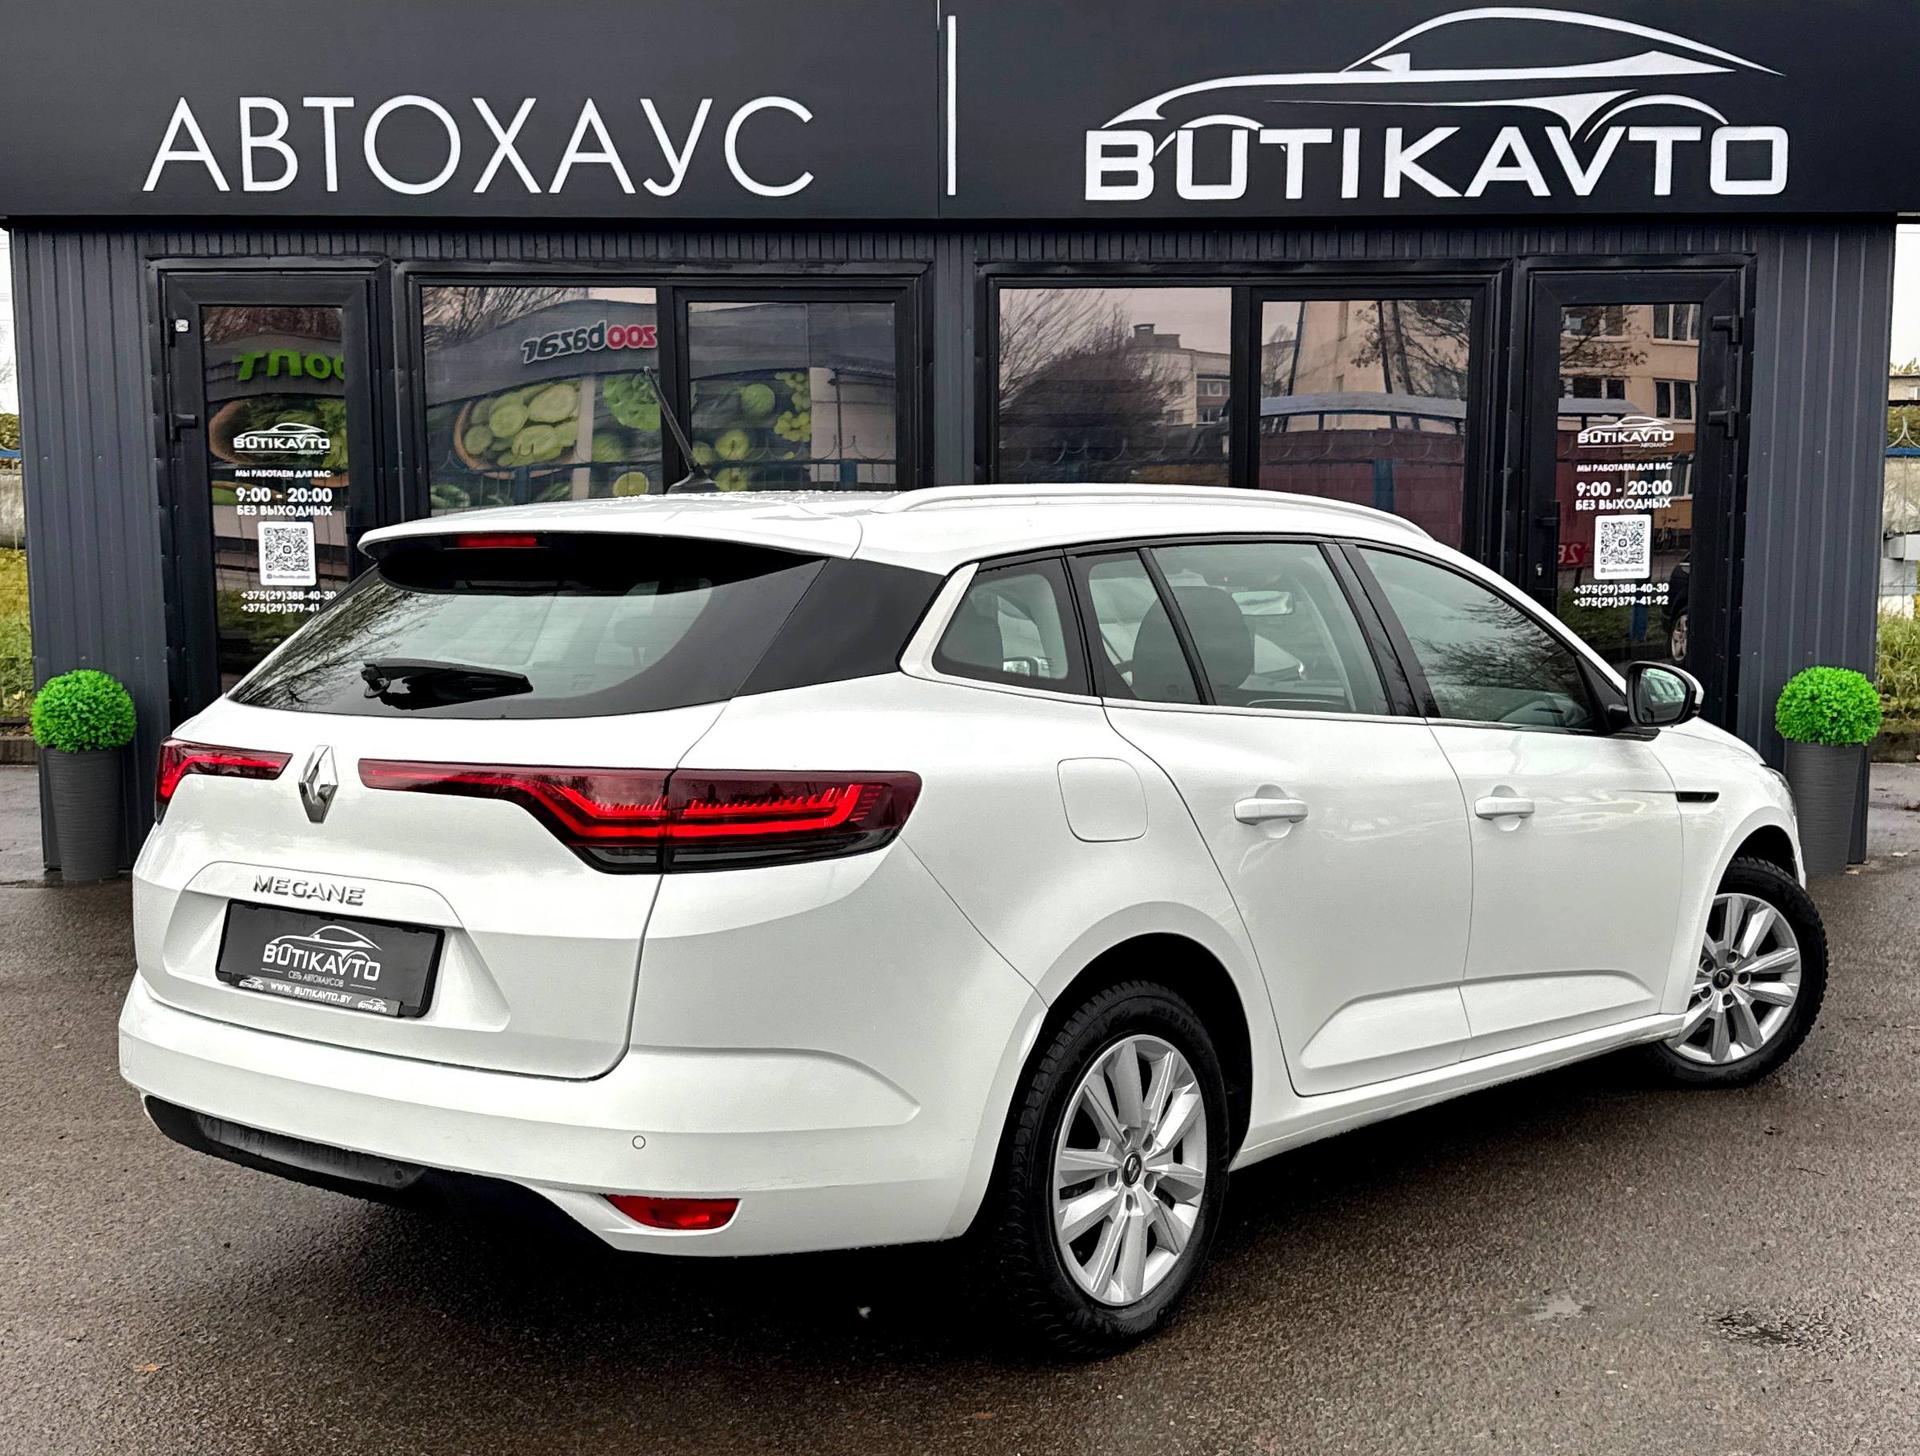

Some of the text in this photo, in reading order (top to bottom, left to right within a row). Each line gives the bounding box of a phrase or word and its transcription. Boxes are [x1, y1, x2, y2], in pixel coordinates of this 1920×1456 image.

[143, 95, 814, 197] АВТОХАУС
[1085, 126, 1789, 200] BUTIKAVTO
[233, 437, 331, 449] BUTIKAVTO
[1577, 430, 1674, 444] BUTIKAVTO
[235, 469, 331, 479] МЫ РАБОТАЕМ ДЛЯ ВАС
[1576, 462, 1673, 473] МЫ РАБОТАЕМ ДЛЯ ВАС
[236, 487, 272, 502] 9:00
[287, 487, 333, 502] 20:00
[1576, 481, 1611, 497] 9:00
[1627, 480, 1673, 495] 20:00
[236, 505, 333, 517] БЕЗ ВЫХОДНЫХ
[1575, 498, 1671, 511] БЕЗ ВЫХОДНЫХ
[240, 590, 337, 602] +375(29)388-40-30
[1573, 583, 1669, 596] +375(29)388-40-30
[1573, 596, 1669, 608] +375(29)379-41-92
[253, 874, 365, 906] MEGANE
[262, 943, 381, 982] BUTIKAVTO
